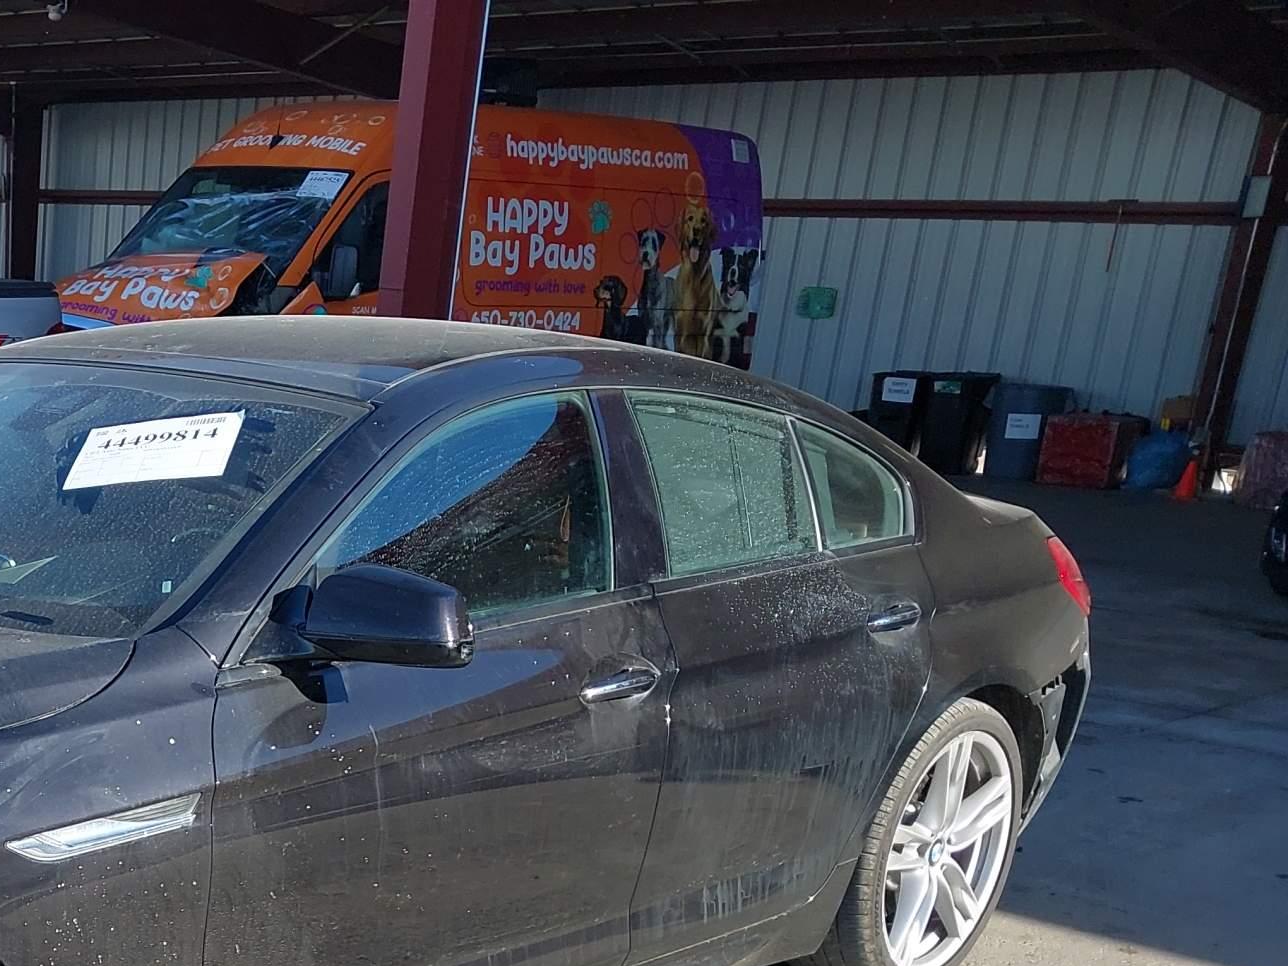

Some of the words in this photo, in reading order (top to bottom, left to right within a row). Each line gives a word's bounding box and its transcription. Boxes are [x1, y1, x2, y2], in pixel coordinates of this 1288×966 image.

[306, 135, 368, 156] MOBILE
[506, 133, 690, 170] happybaypawsca.com
[487, 196, 569, 236] HAPPY
[469, 230, 520, 275] Bay
[528, 233, 596, 271] Paws
[63, 279, 120, 303] Bay
[120, 277, 201, 311] Paws
[475, 278, 531, 296] grooming
[535, 279, 560, 294] with
[563, 281, 587, 294] love
[471, 310, 581, 331] 650-730-0424
[97, 427, 219, 449] 44499814
